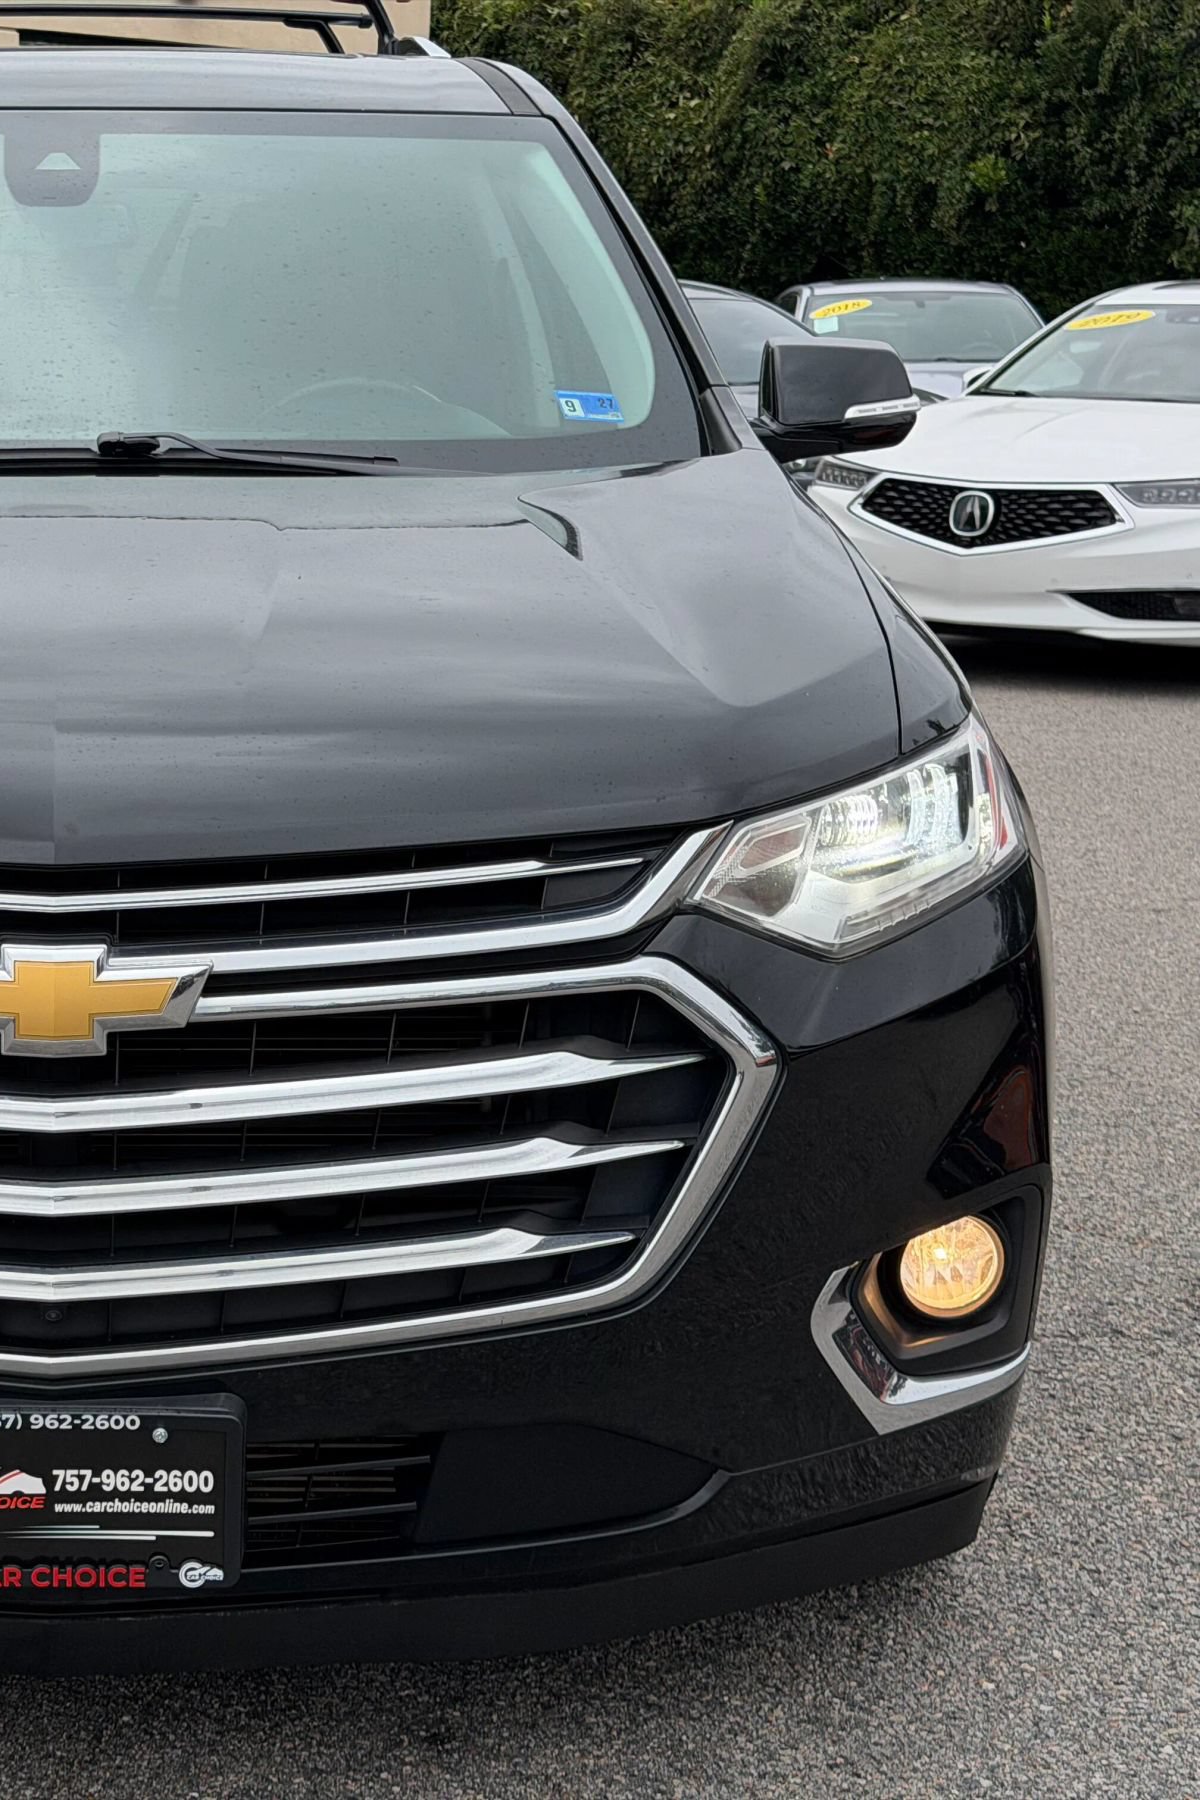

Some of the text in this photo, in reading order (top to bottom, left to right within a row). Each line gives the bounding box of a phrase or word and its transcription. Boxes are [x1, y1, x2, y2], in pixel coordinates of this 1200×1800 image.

[565, 397, 614, 412] 9 27
[29, 1413, 141, 1430] 962-2600
[52, 1469, 214, 1493] 757-962-2600
[54, 1498, 215, 1515] www.carchoiceonline.com
[30, 1566, 146, 1588] CHOICE
